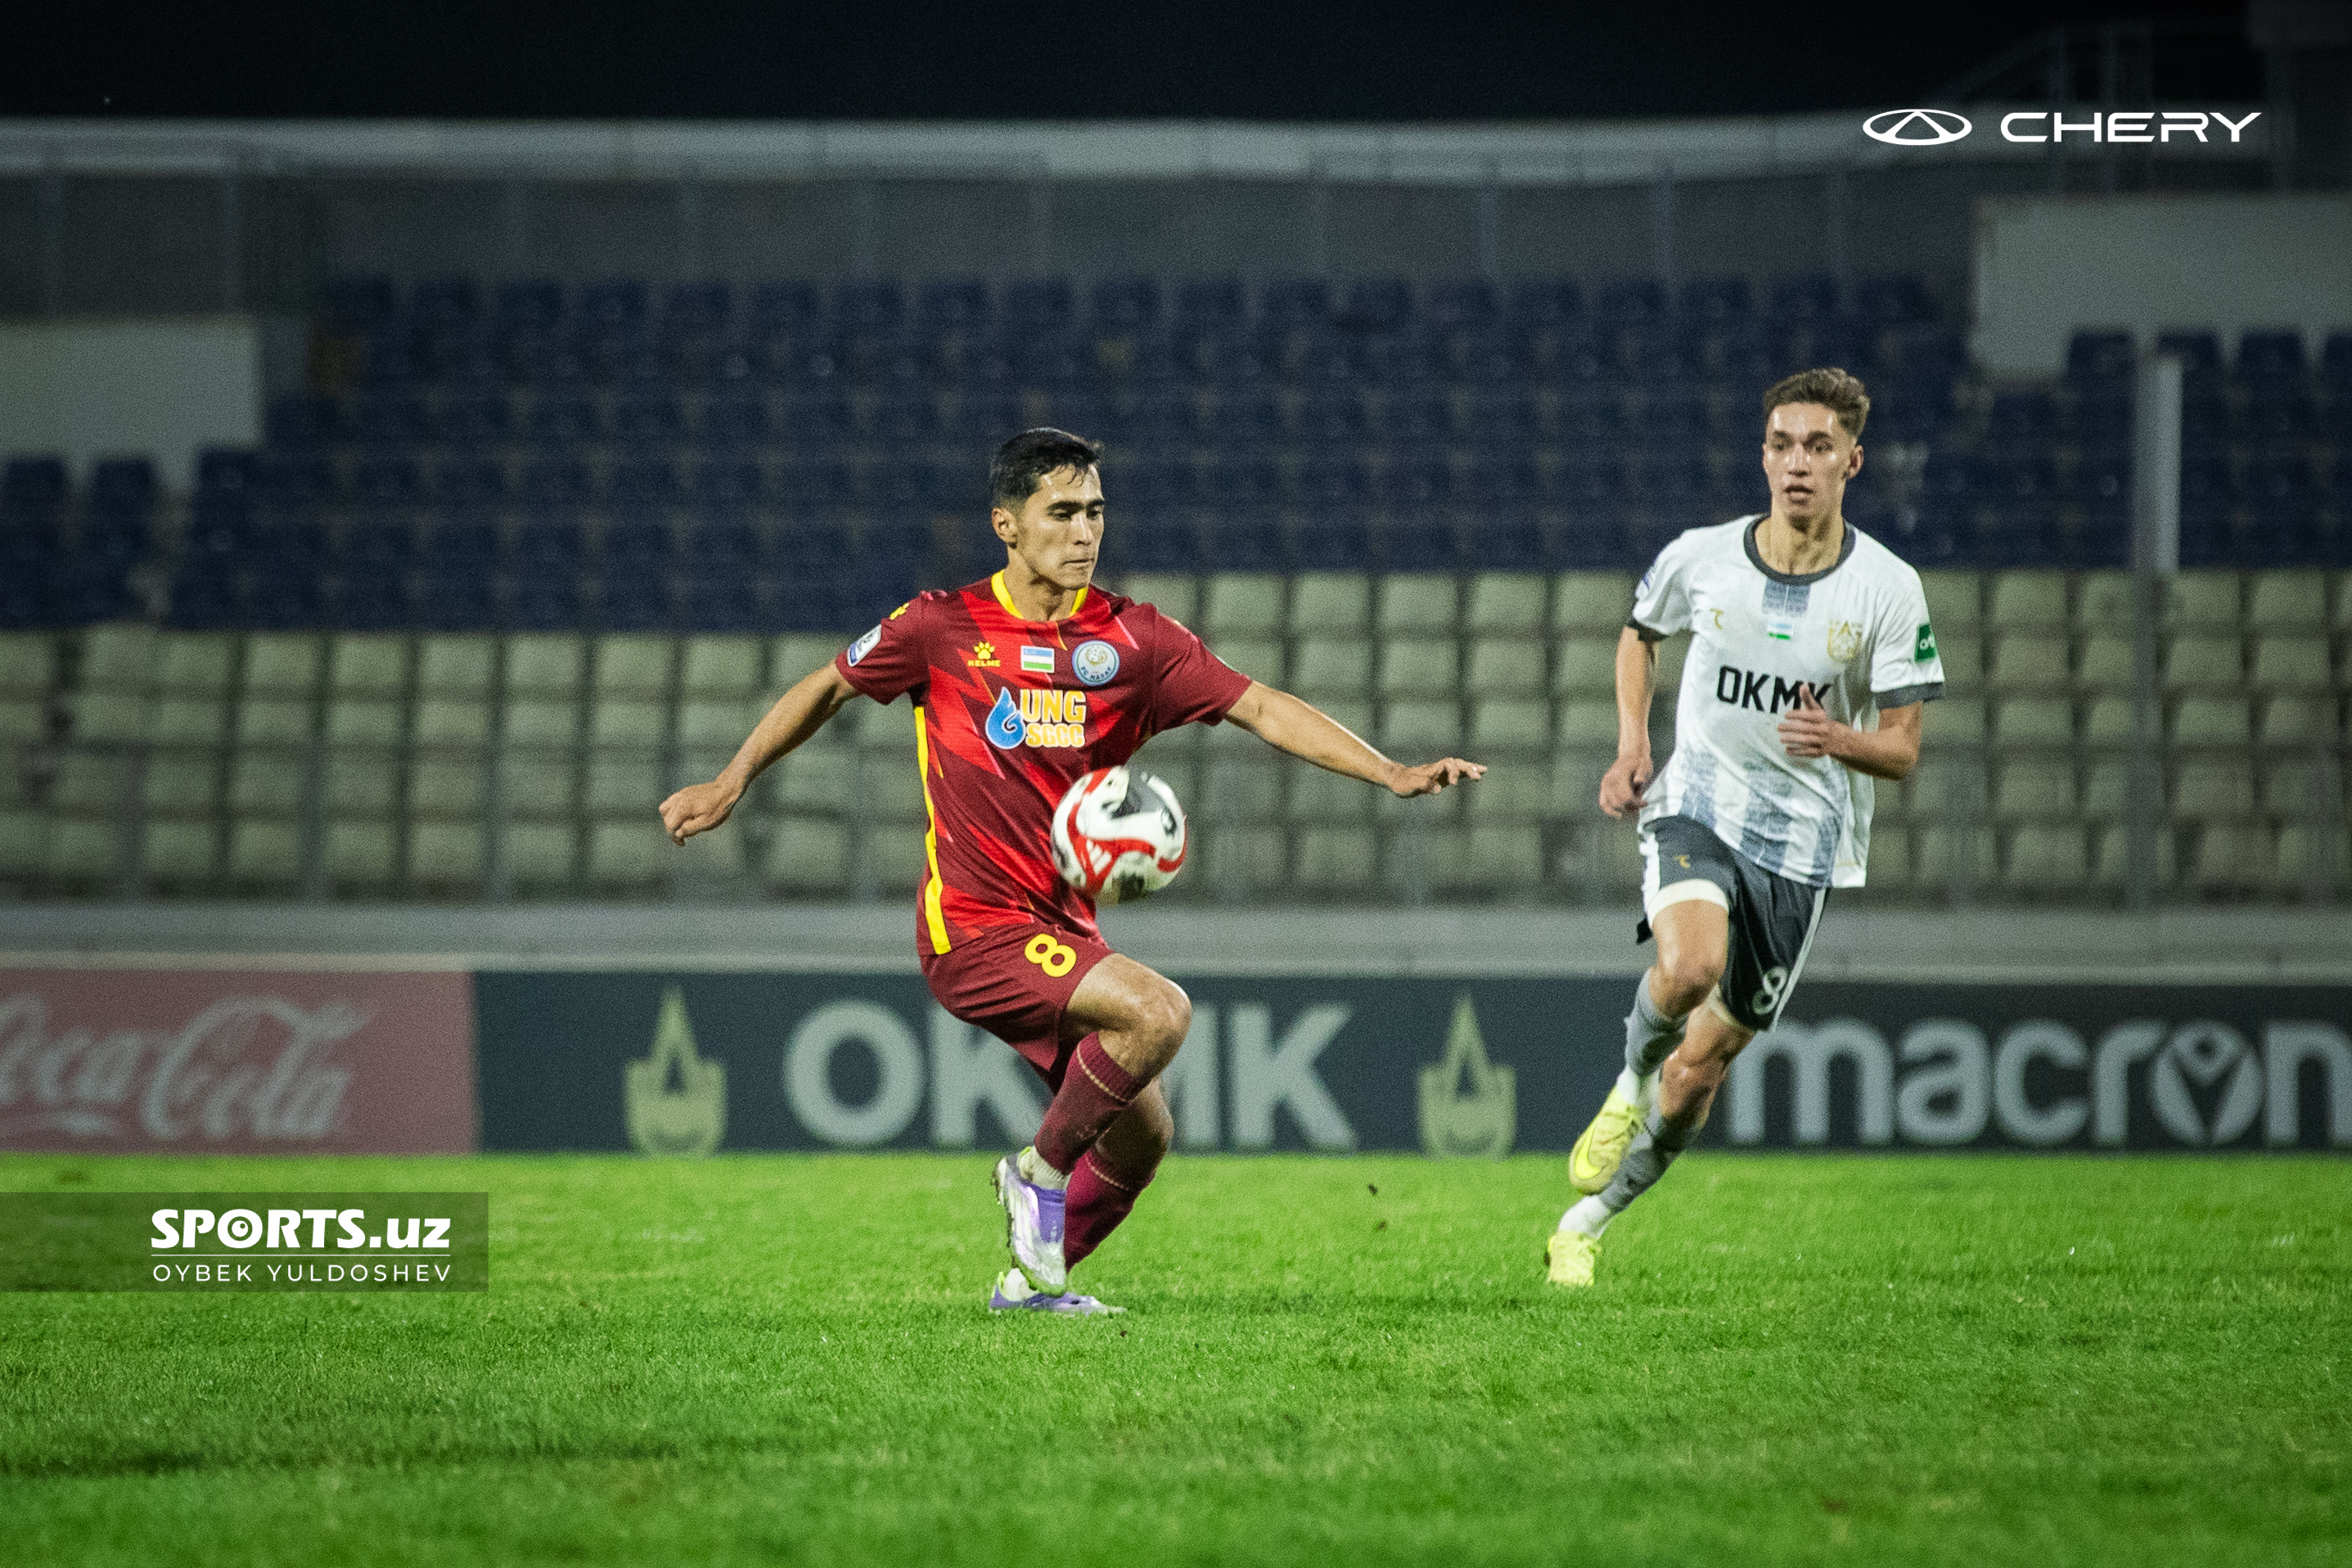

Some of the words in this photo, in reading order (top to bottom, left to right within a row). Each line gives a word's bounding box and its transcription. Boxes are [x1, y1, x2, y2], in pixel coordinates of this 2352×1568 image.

[967, 660, 1002, 668] KELME
[1020, 688, 1087, 723] UNG
[1025, 723, 1086, 748] SGCC
[1024, 933, 1077, 978] 8
[1752, 966, 1789, 1016] 8
